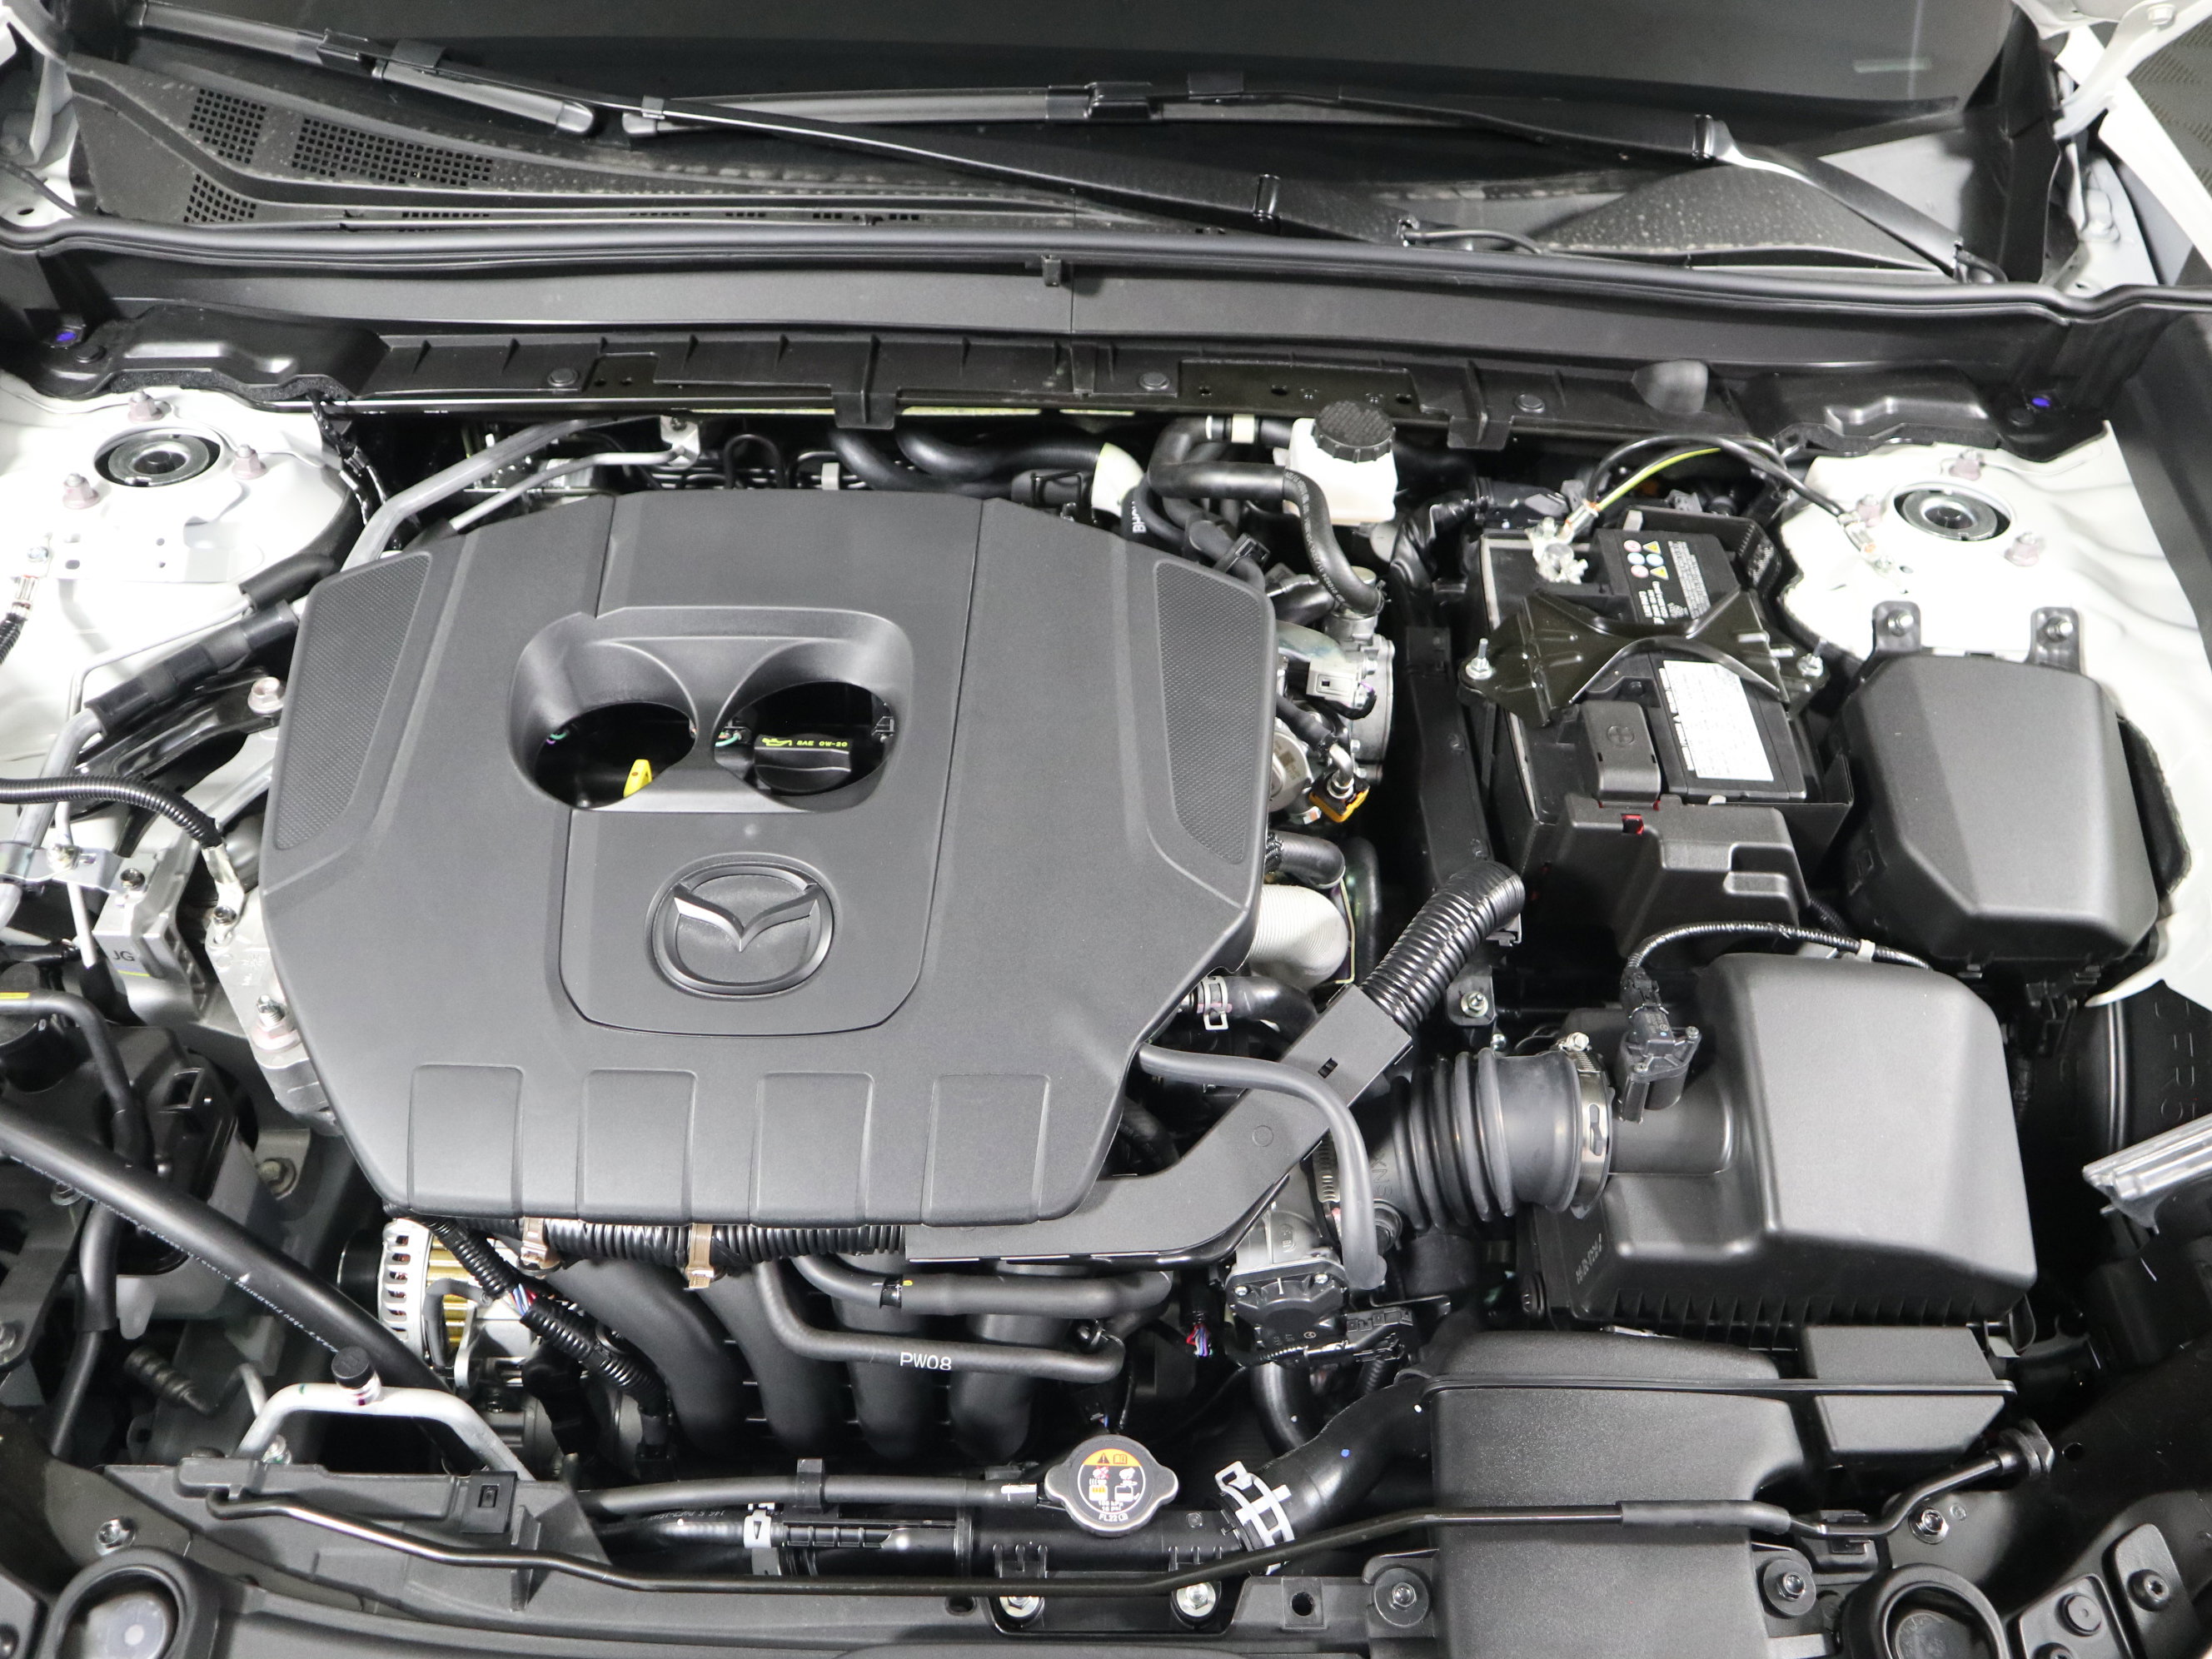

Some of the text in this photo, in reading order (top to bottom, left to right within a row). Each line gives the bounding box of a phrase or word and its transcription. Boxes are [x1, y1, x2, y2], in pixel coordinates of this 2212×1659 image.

[112, 949, 135, 962] JG
[899, 1351, 952, 1371] PW08
[1098, 1512, 1118, 1522] FL22
